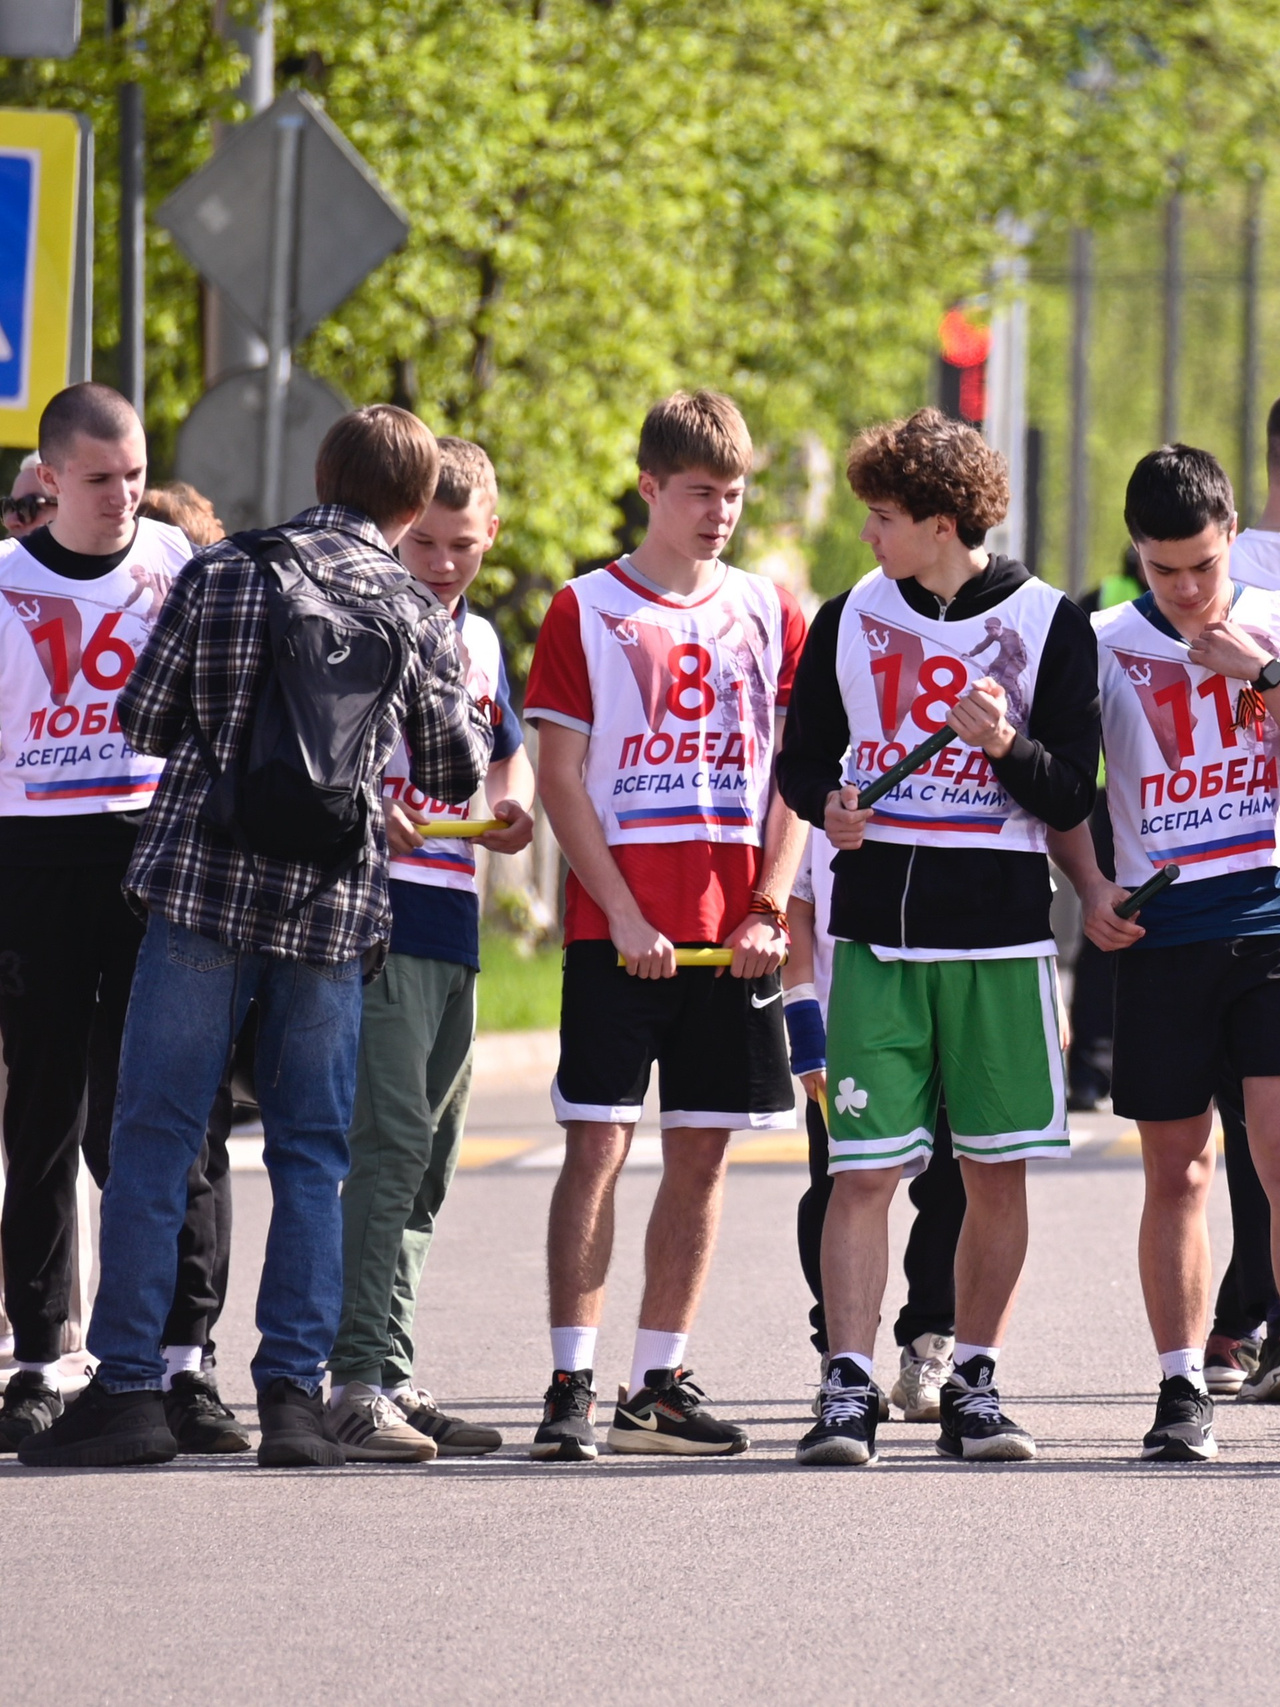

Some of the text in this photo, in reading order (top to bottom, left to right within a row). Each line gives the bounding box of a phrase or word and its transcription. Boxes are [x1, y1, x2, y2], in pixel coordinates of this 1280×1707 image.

[31, 612, 137, 695] 16
[870, 653, 968, 735] 18
[15, 744, 92, 768] ВСЕГДА
[856, 741, 1000, 788] ПОБЕД
[613, 773, 685, 796] ВСЕГДА
[708, 773, 748, 791] НАМ
[1141, 754, 1279, 810] ПОБЕДА
[1140, 807, 1213, 836] ВСЕГДА
